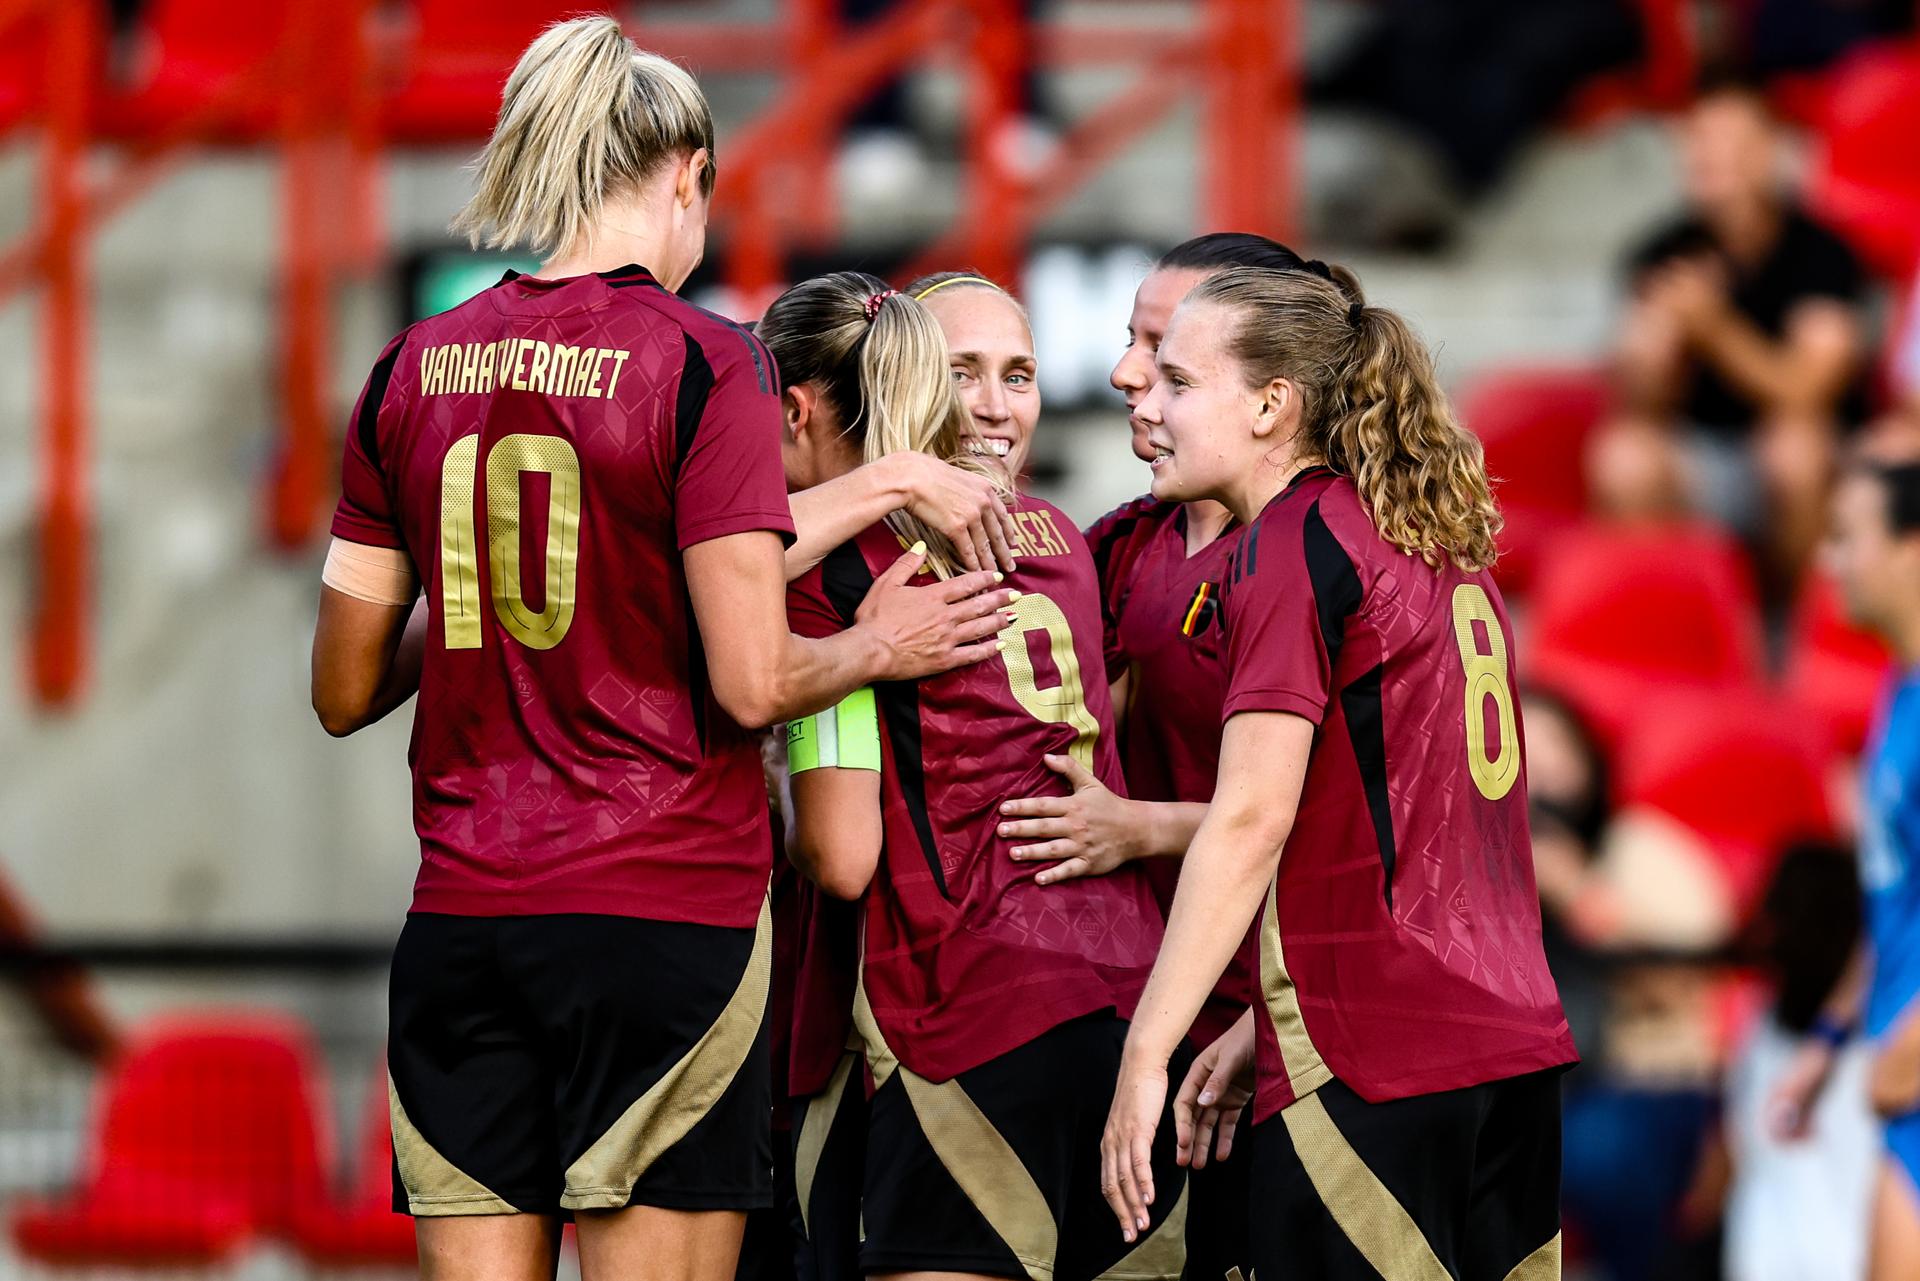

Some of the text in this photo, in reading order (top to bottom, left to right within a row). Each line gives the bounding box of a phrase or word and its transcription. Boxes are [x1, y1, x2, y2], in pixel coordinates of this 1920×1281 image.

[441, 433, 580, 650] 10
[996, 592, 1100, 776] 9
[1452, 583, 1520, 801] 8
